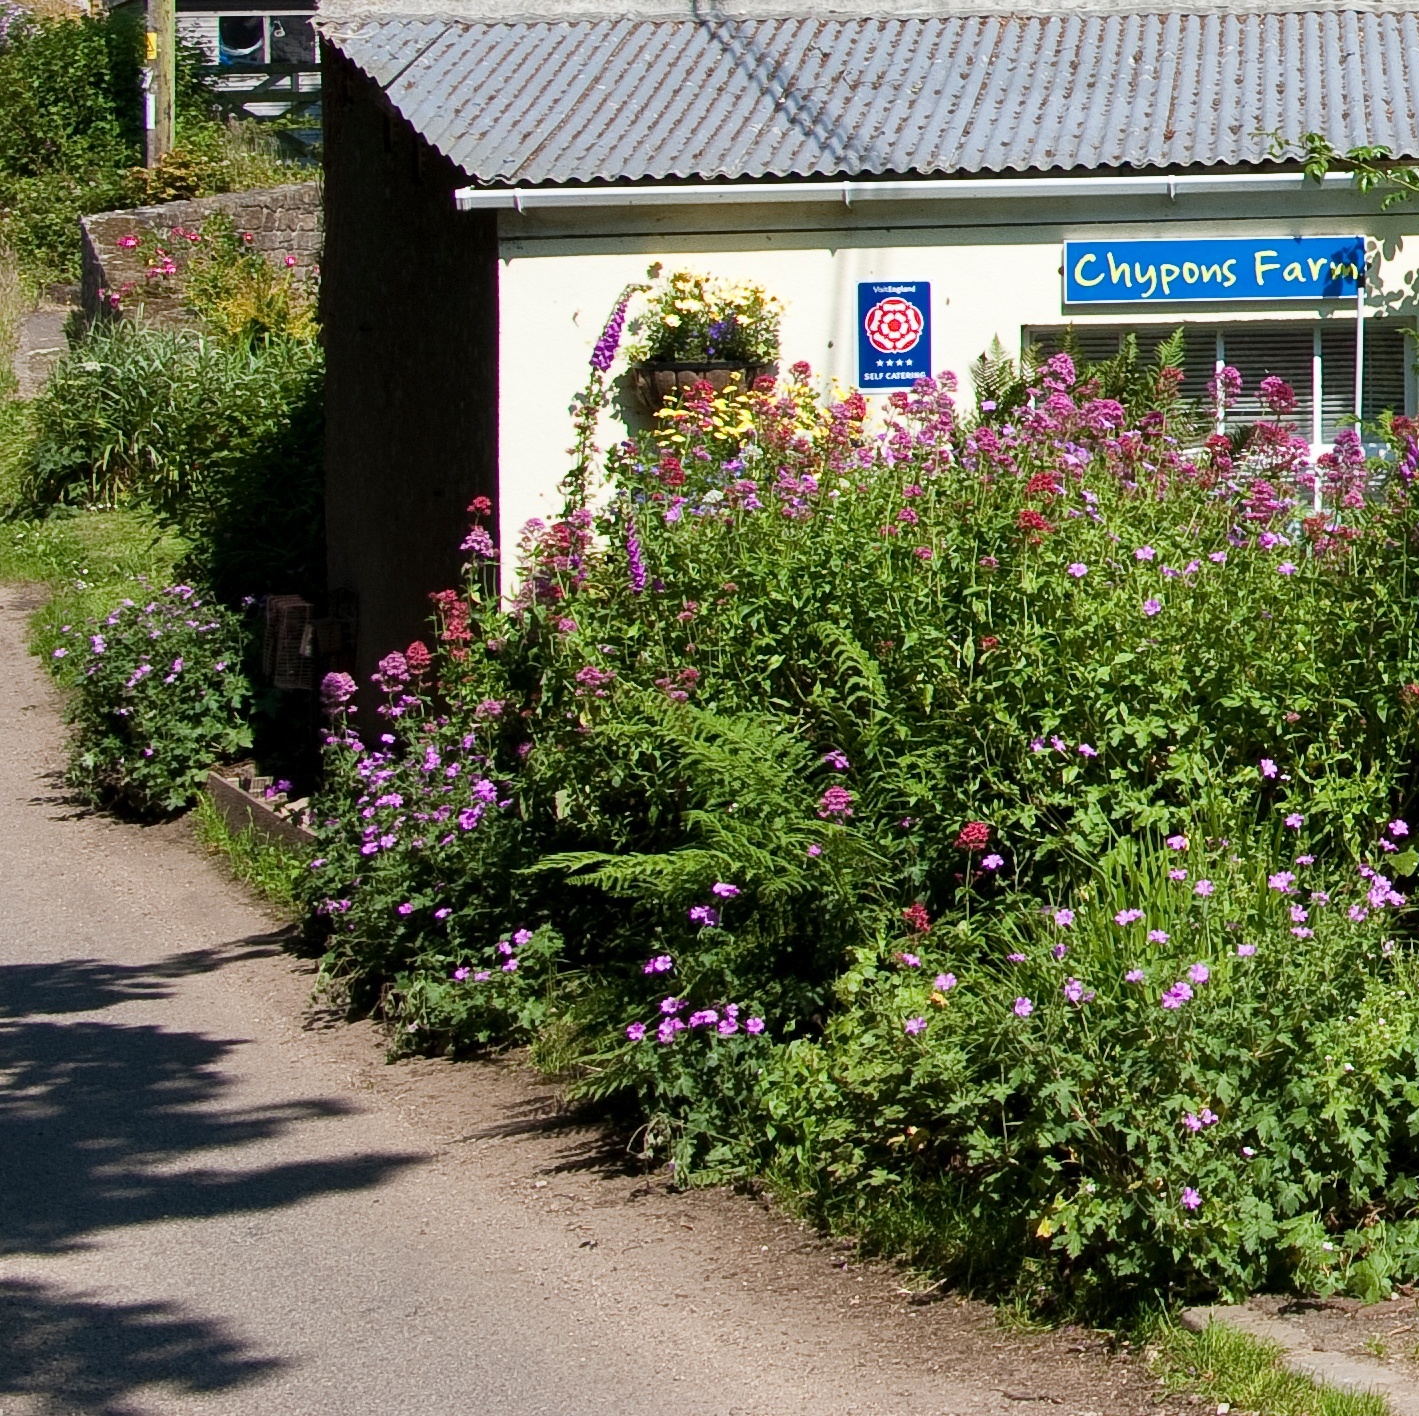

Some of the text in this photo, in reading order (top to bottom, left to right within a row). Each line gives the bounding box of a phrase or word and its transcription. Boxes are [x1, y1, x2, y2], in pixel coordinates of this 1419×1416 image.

[1074, 249, 1359, 298] Chypons Farm
[863, 371, 927, 381] SELF CATERING
